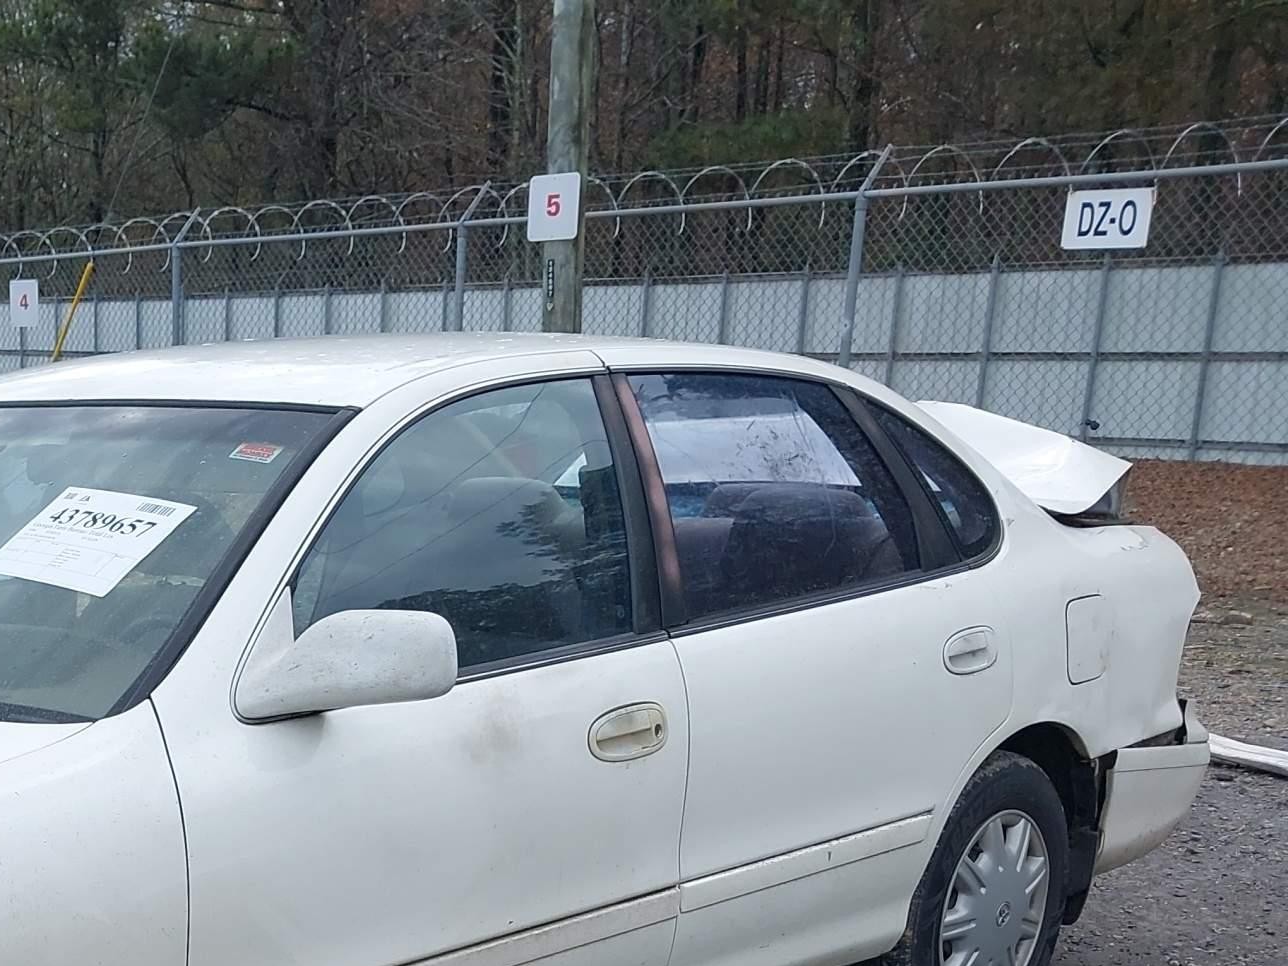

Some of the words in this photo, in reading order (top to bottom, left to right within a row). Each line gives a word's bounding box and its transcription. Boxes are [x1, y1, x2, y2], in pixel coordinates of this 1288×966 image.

[546, 194, 561, 217] 5
[20, 293, 29, 310] 4
[50, 507, 157, 538] 43789657
